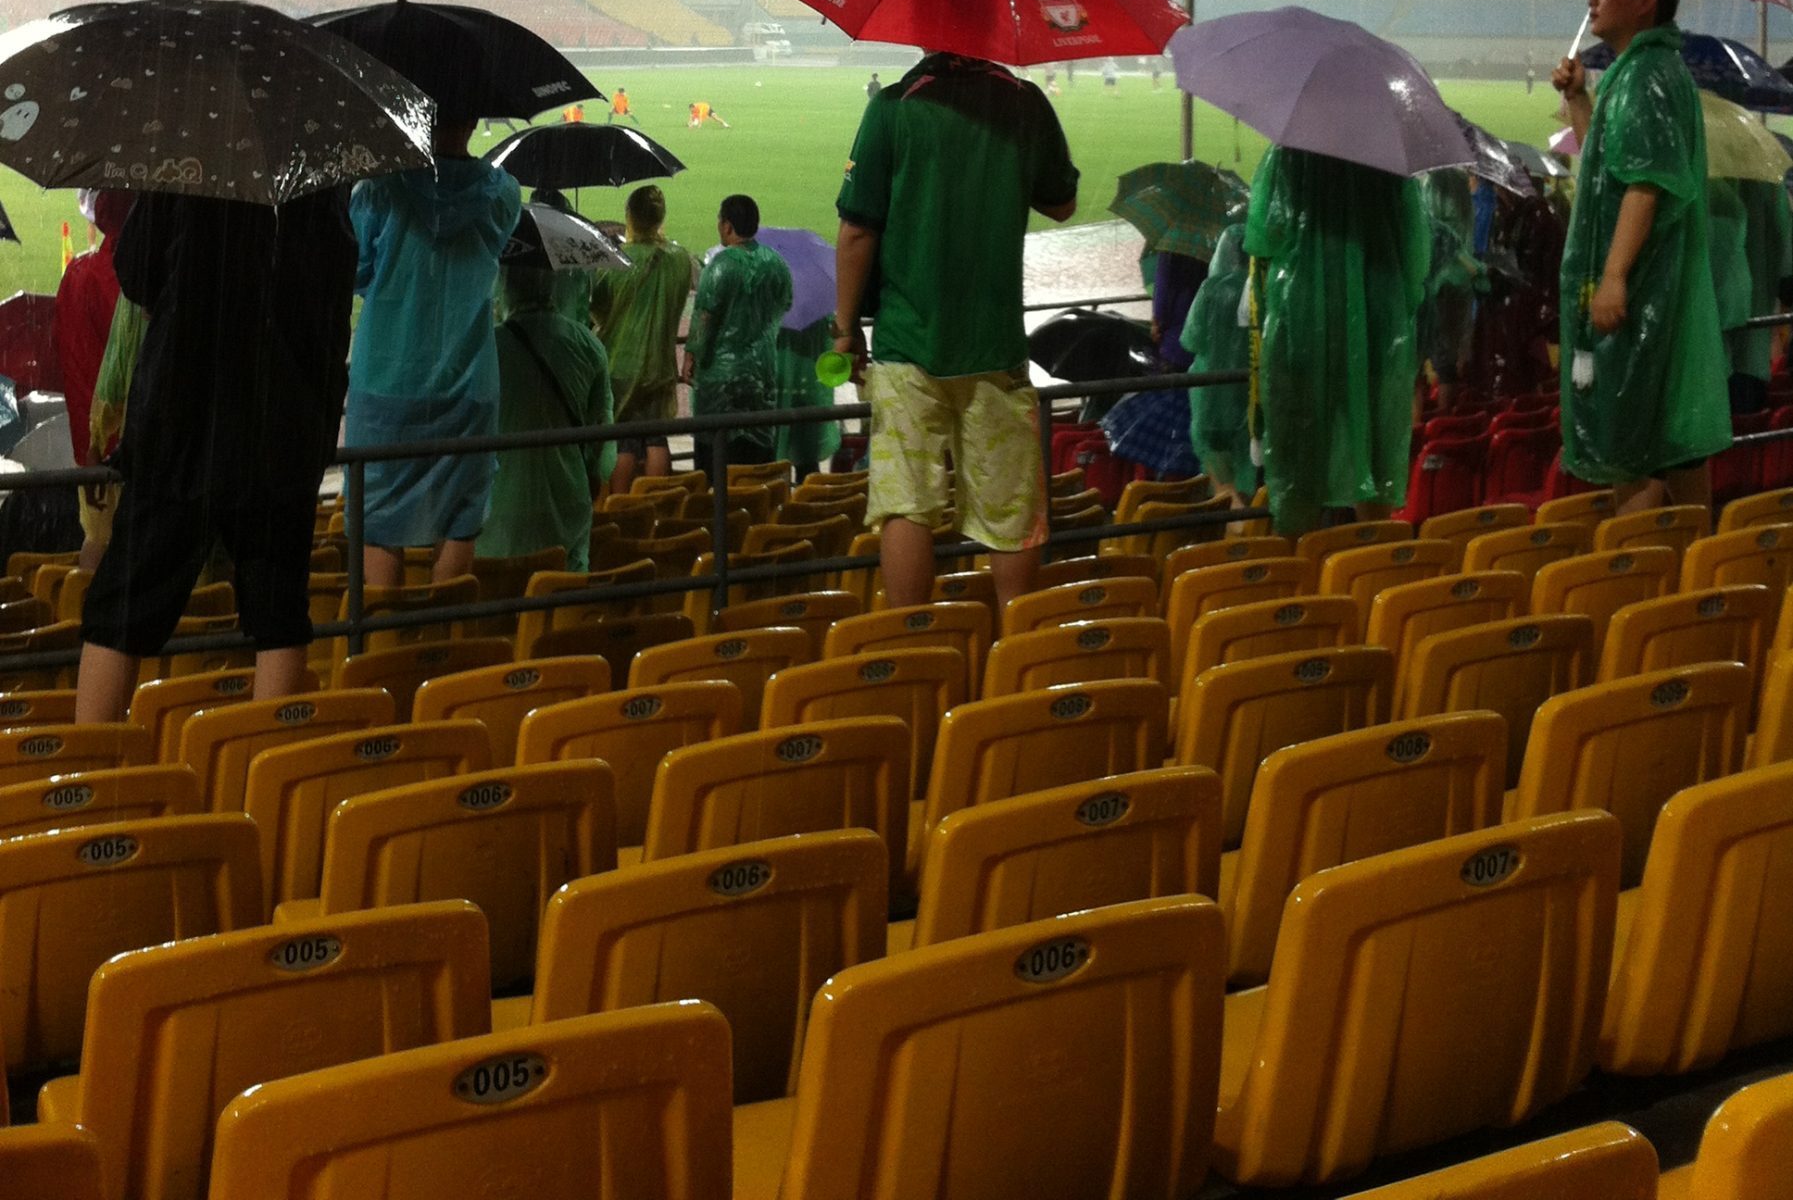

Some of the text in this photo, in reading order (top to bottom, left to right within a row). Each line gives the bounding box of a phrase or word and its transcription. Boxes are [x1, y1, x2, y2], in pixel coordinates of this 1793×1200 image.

[511, 669, 533, 685] 007
[284, 703, 309, 720] 006
[630, 697, 654, 716] 007
[27, 739, 53, 754] 005
[363, 738, 392, 755] 006
[786, 739, 813, 758] 007
[1395, 737, 1424, 757] 008
[53, 787, 84, 806] 005
[468, 785, 502, 804] 006
[1088, 797, 1120, 820] 007
[90, 839, 126, 861] 005
[1473, 851, 1510, 881] 007
[722, 865, 760, 889] 006
[284, 939, 328, 964] 005
[1029, 942, 1076, 976] 006
[472, 1057, 530, 1097] 005
